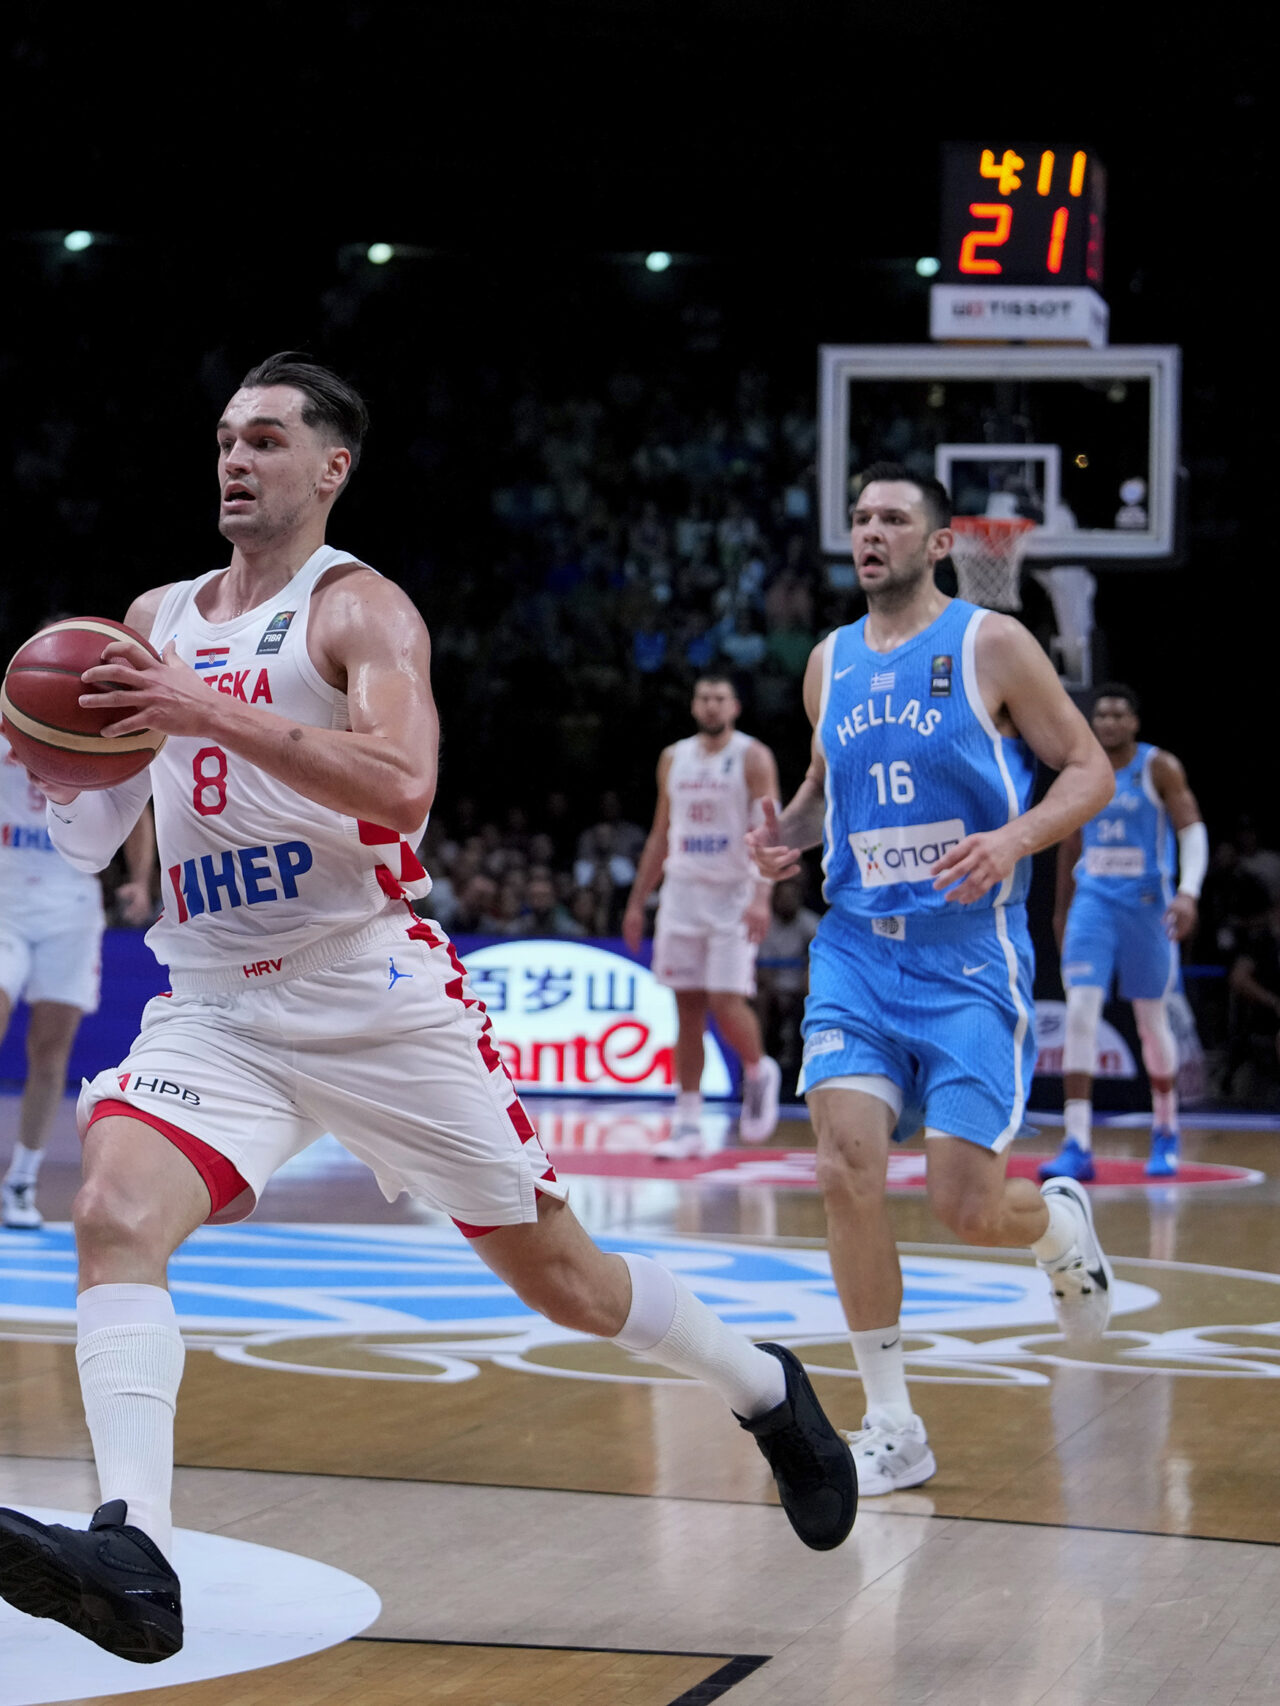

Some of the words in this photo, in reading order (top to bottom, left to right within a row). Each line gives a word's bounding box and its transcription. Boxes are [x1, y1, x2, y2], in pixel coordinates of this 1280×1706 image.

[979, 149, 1087, 197] 4:11
[958, 203, 1069, 275] 21
[263, 633, 282, 643] FIBA
[836, 694, 942, 746] HELLAS
[192, 746, 228, 816] 8
[869, 760, 915, 806] 16
[200, 841, 313, 913] HEP
[243, 957, 283, 978] HRV
[133, 1076, 201, 1106] HPB
